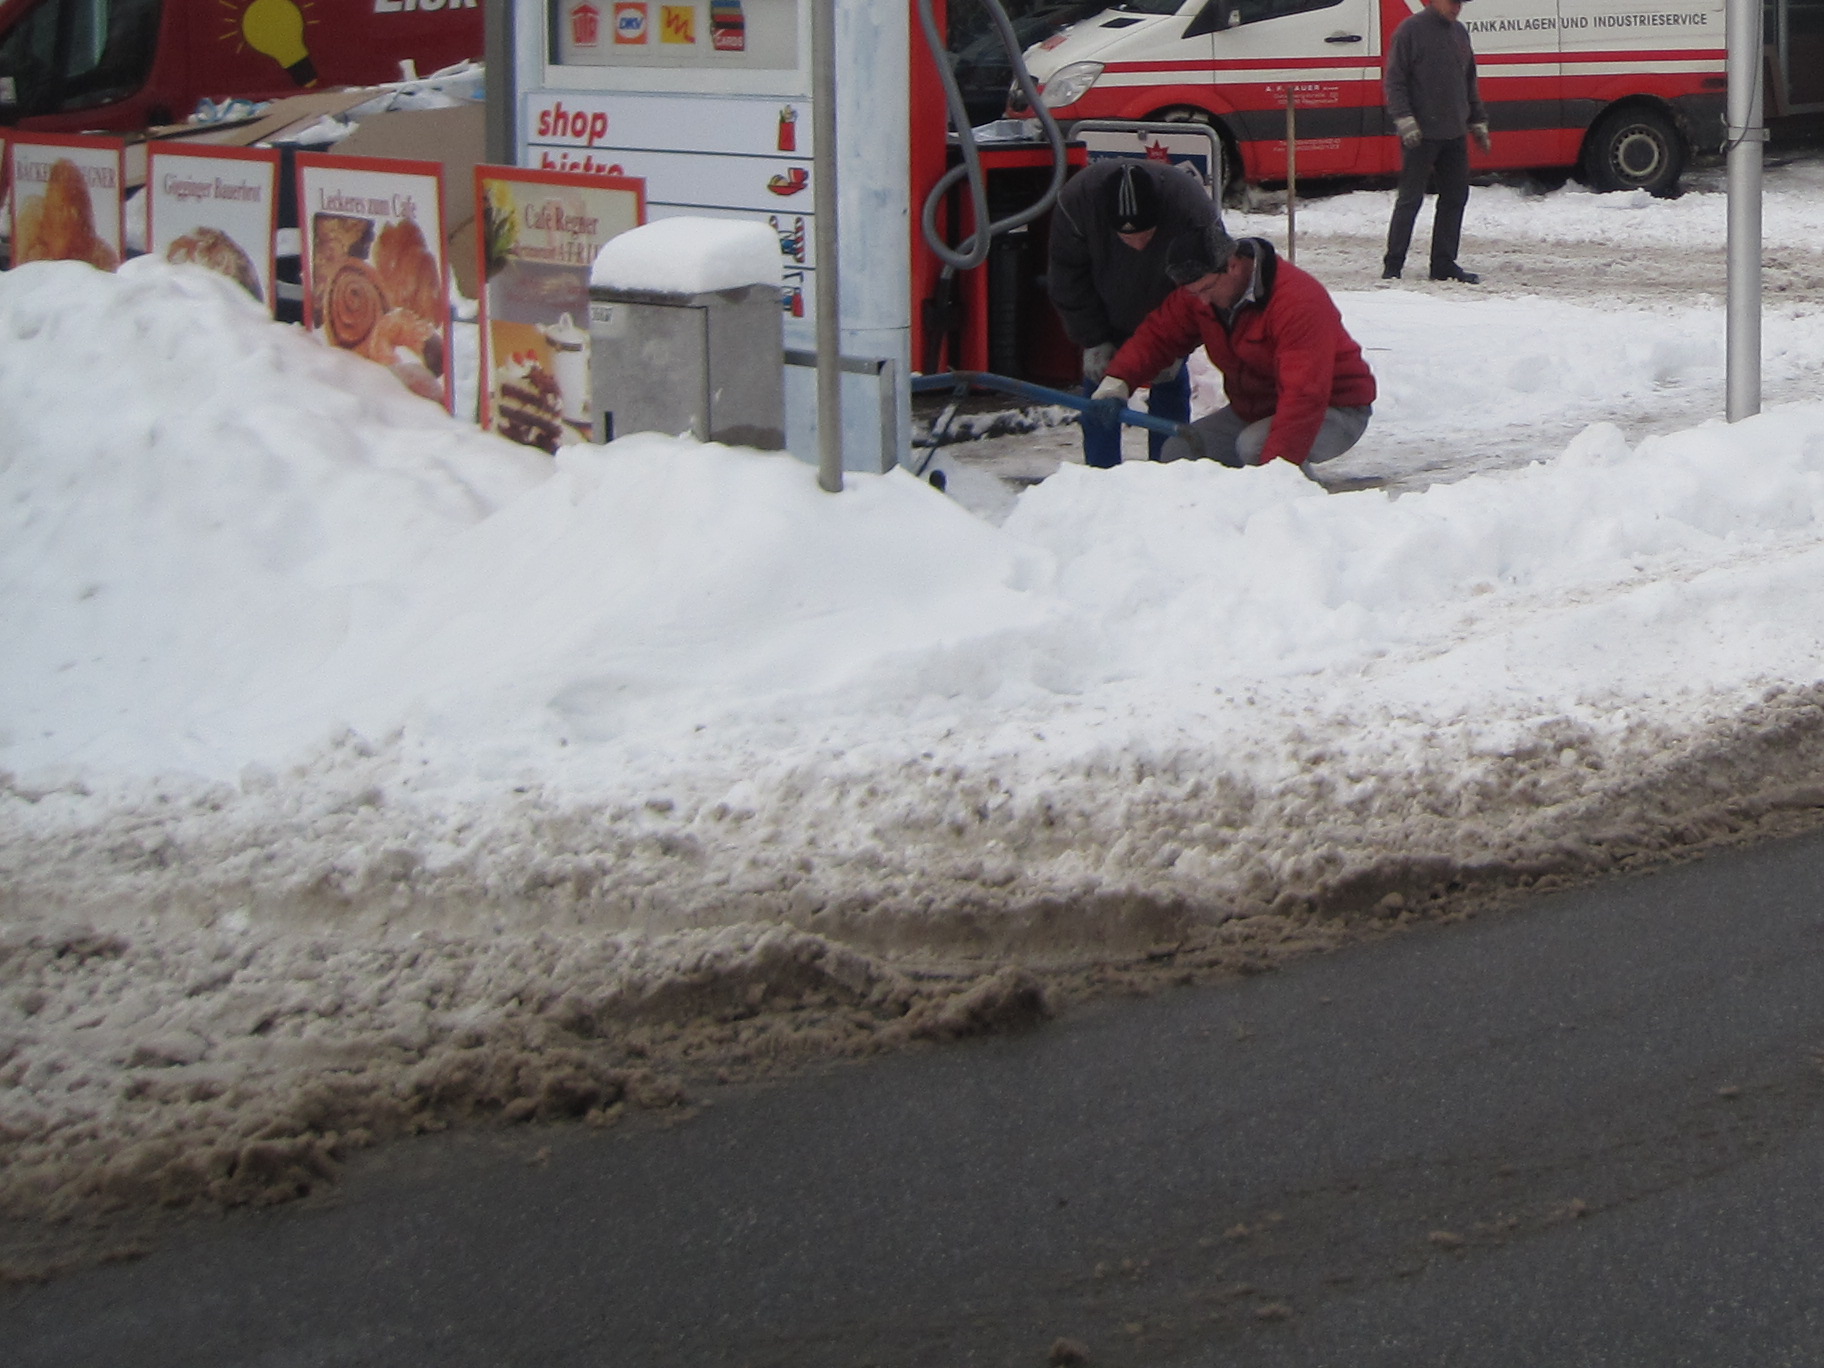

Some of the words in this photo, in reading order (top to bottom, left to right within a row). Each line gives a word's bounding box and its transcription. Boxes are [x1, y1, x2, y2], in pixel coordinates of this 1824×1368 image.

[619, 17, 644, 30] DKV
[1465, 17, 1556, 33] TANKANLAGEN
[1561, 16, 1588, 30] UND
[1593, 13, 1707, 27] INDUSTRIESERVICE
[538, 101, 609, 146] shop
